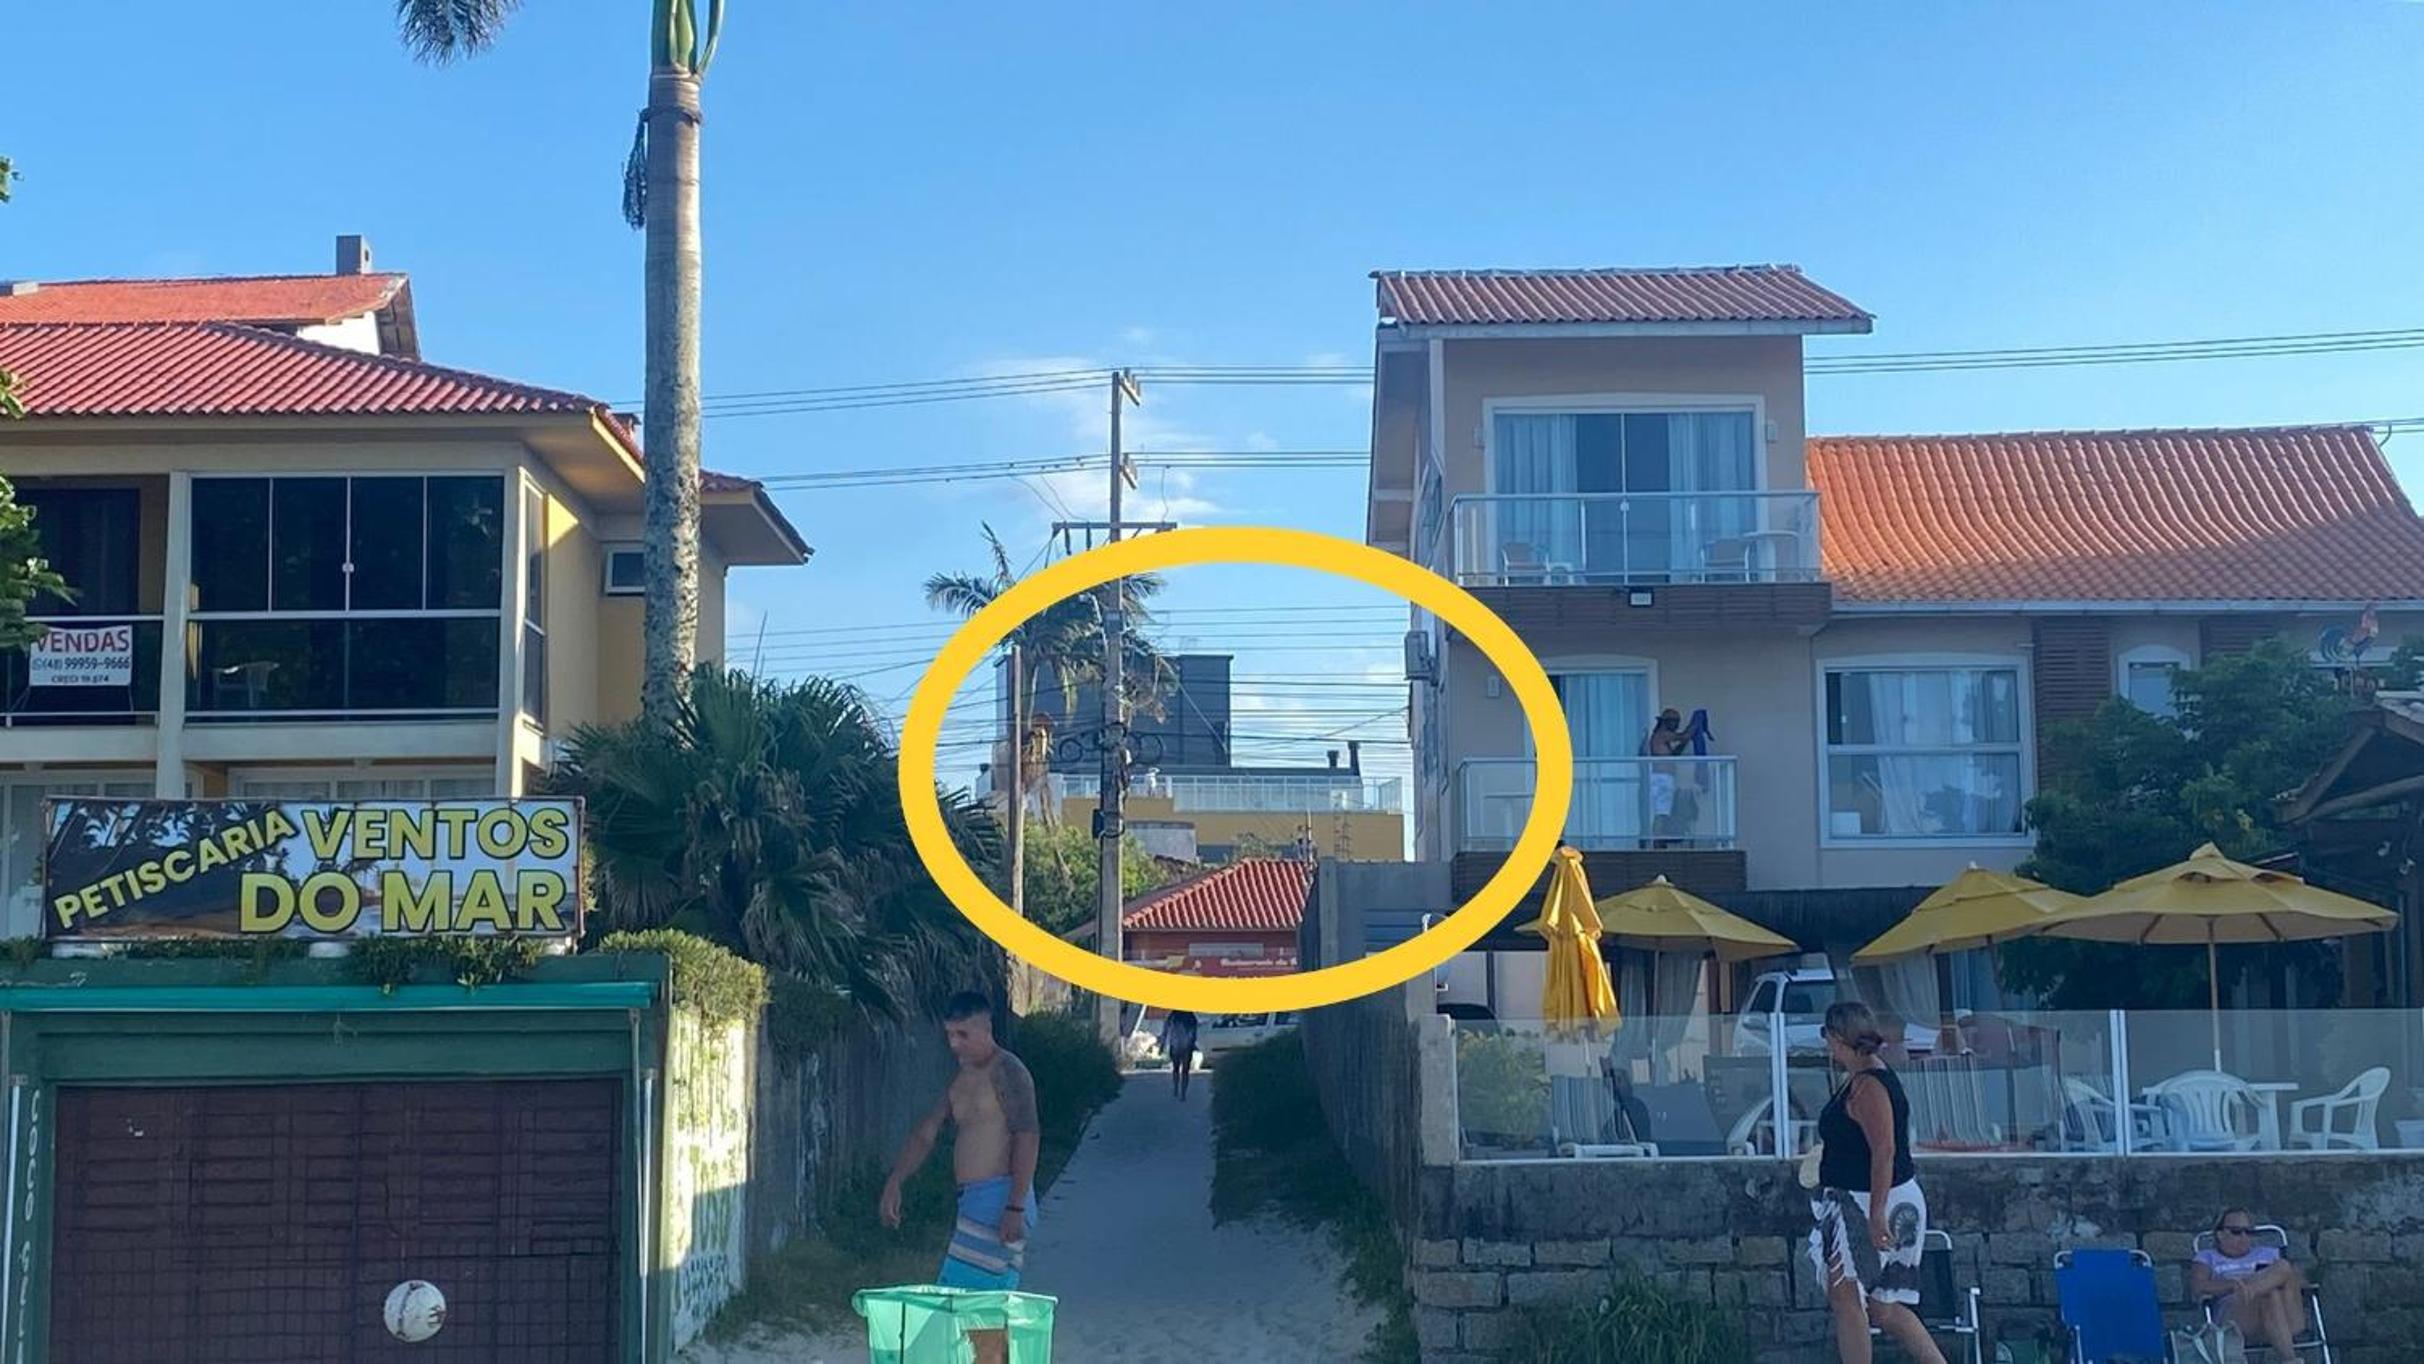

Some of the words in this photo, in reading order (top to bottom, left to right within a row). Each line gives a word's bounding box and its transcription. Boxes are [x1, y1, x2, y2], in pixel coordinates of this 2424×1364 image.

[35, 630, 130, 652] VENDAS
[302, 808, 569, 860] VENTOS
[54, 808, 297, 929] PETISCARIA
[241, 870, 361, 933] DO
[382, 870, 567, 933] MAR
